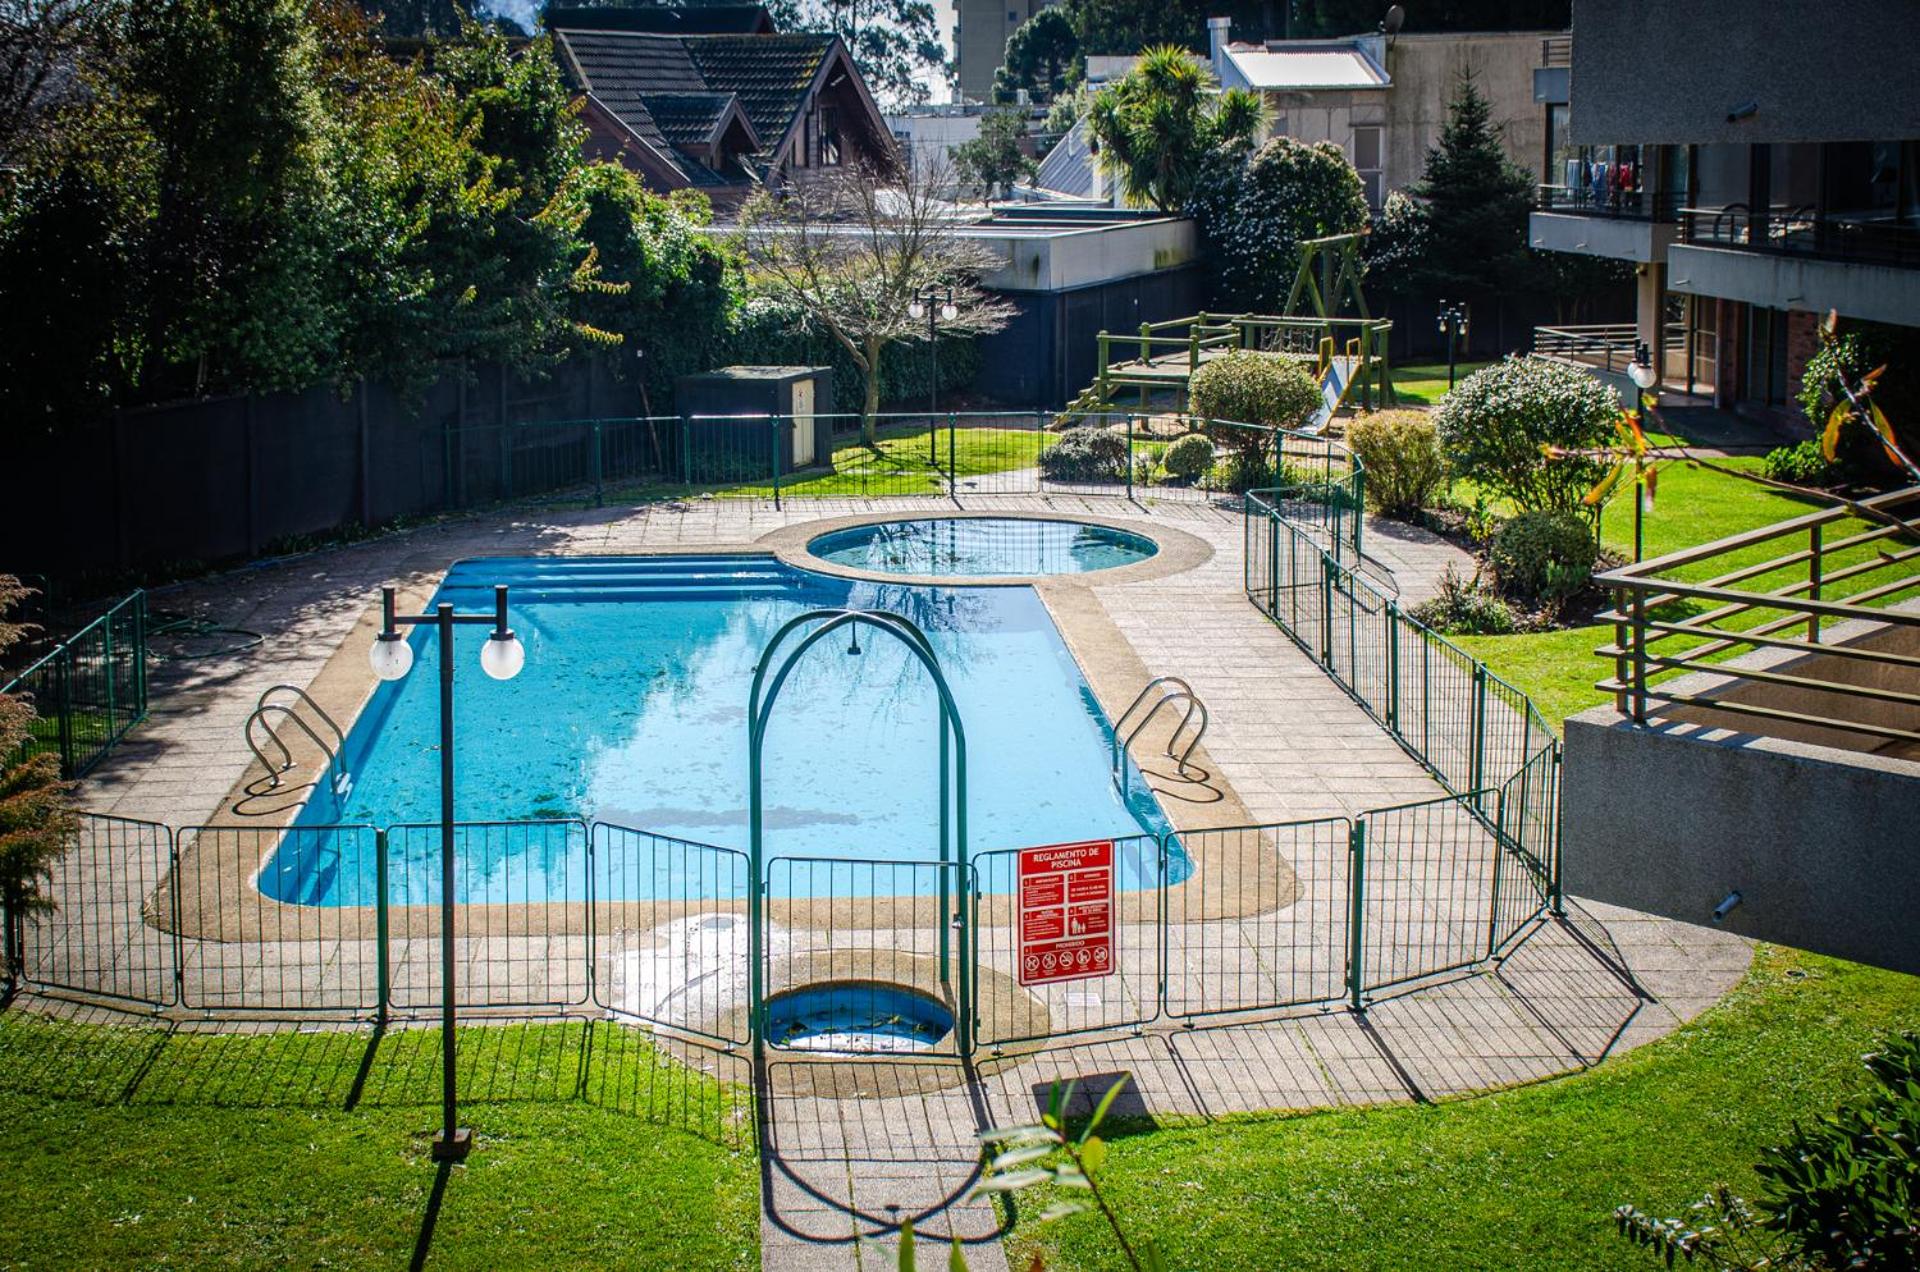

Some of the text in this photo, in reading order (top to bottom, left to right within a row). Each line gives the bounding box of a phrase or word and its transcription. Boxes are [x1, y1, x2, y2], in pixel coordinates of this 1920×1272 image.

[1033, 847, 1099, 862] REGLAMENTO DE
[1051, 859, 1081, 869] PISCINA
